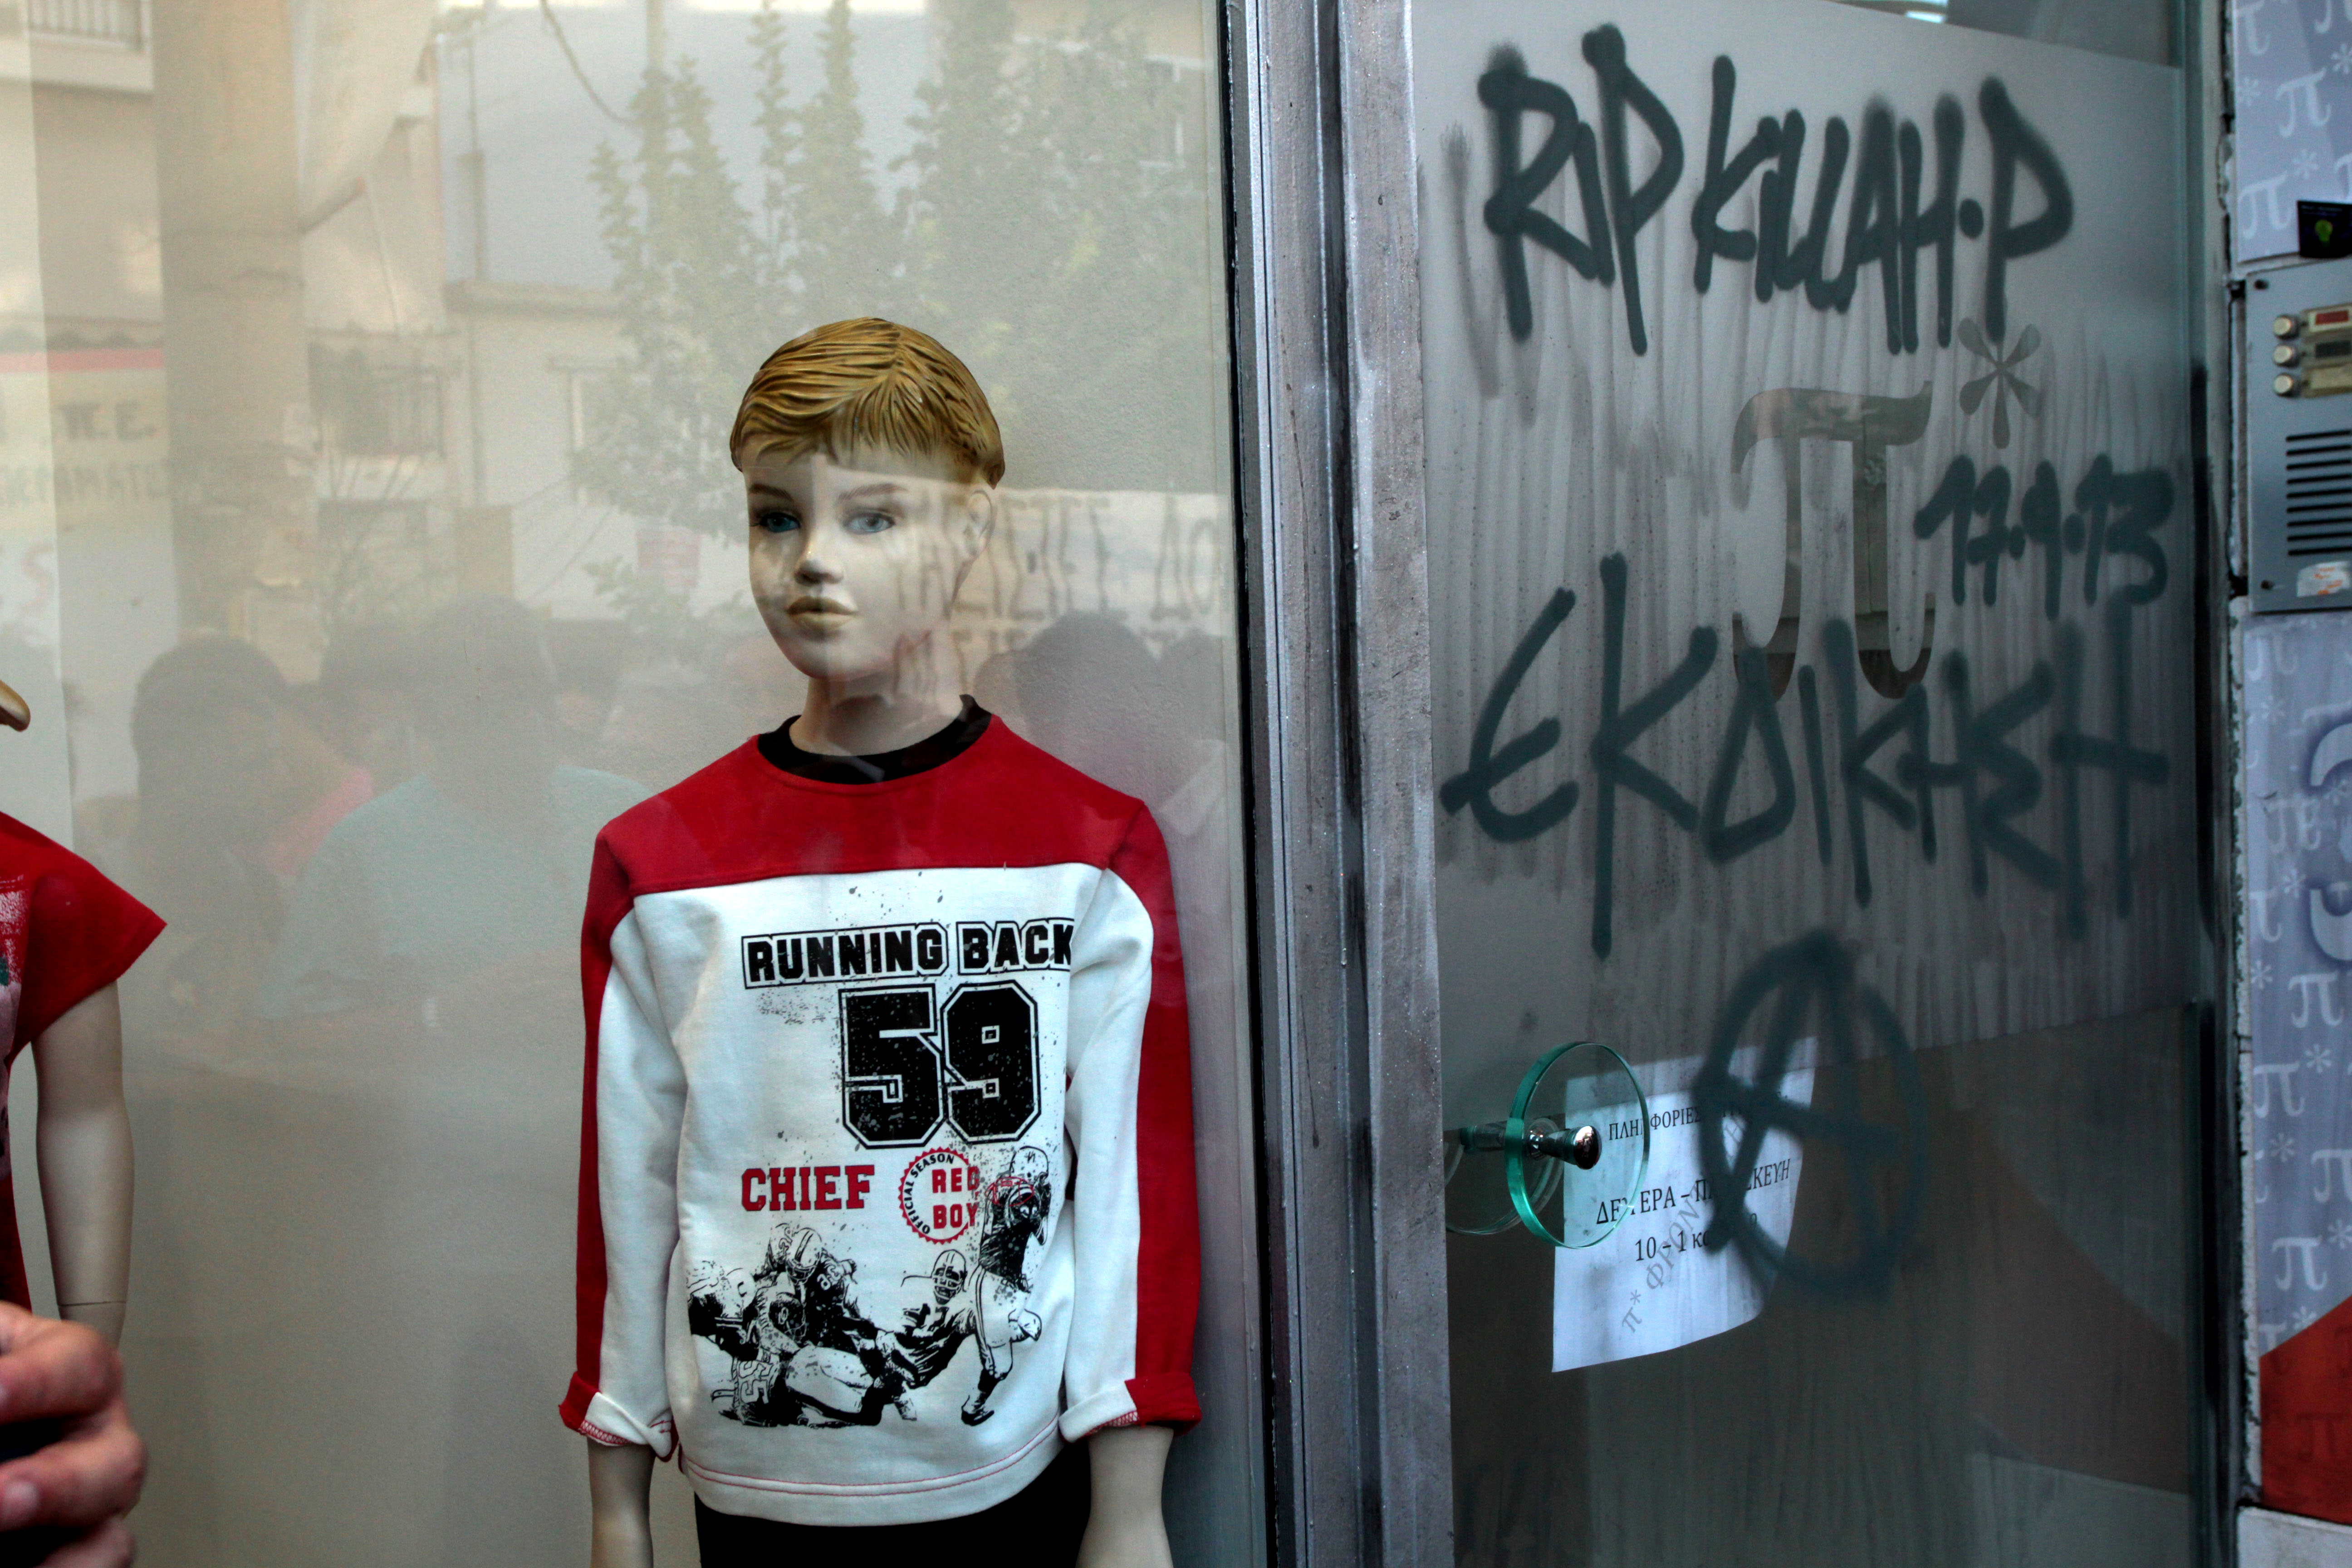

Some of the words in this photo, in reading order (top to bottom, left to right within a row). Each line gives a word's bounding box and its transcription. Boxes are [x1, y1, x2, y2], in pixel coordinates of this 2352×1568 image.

[1478, 24, 1683, 355] RIP
[746, 926, 944, 984] RUNNING
[961, 923, 1074, 970] BACK
[838, 982, 1041, 1149] 59
[741, 1164, 876, 1212] CHIEF
[911, 1153, 955, 1178] SEASON
[903, 1181, 931, 1235] OFFICIAL
[932, 1202, 980, 1230] BOY
[1635, 1237, 1656, 1261] 10
[1677, 1230, 1686, 1252] 1
